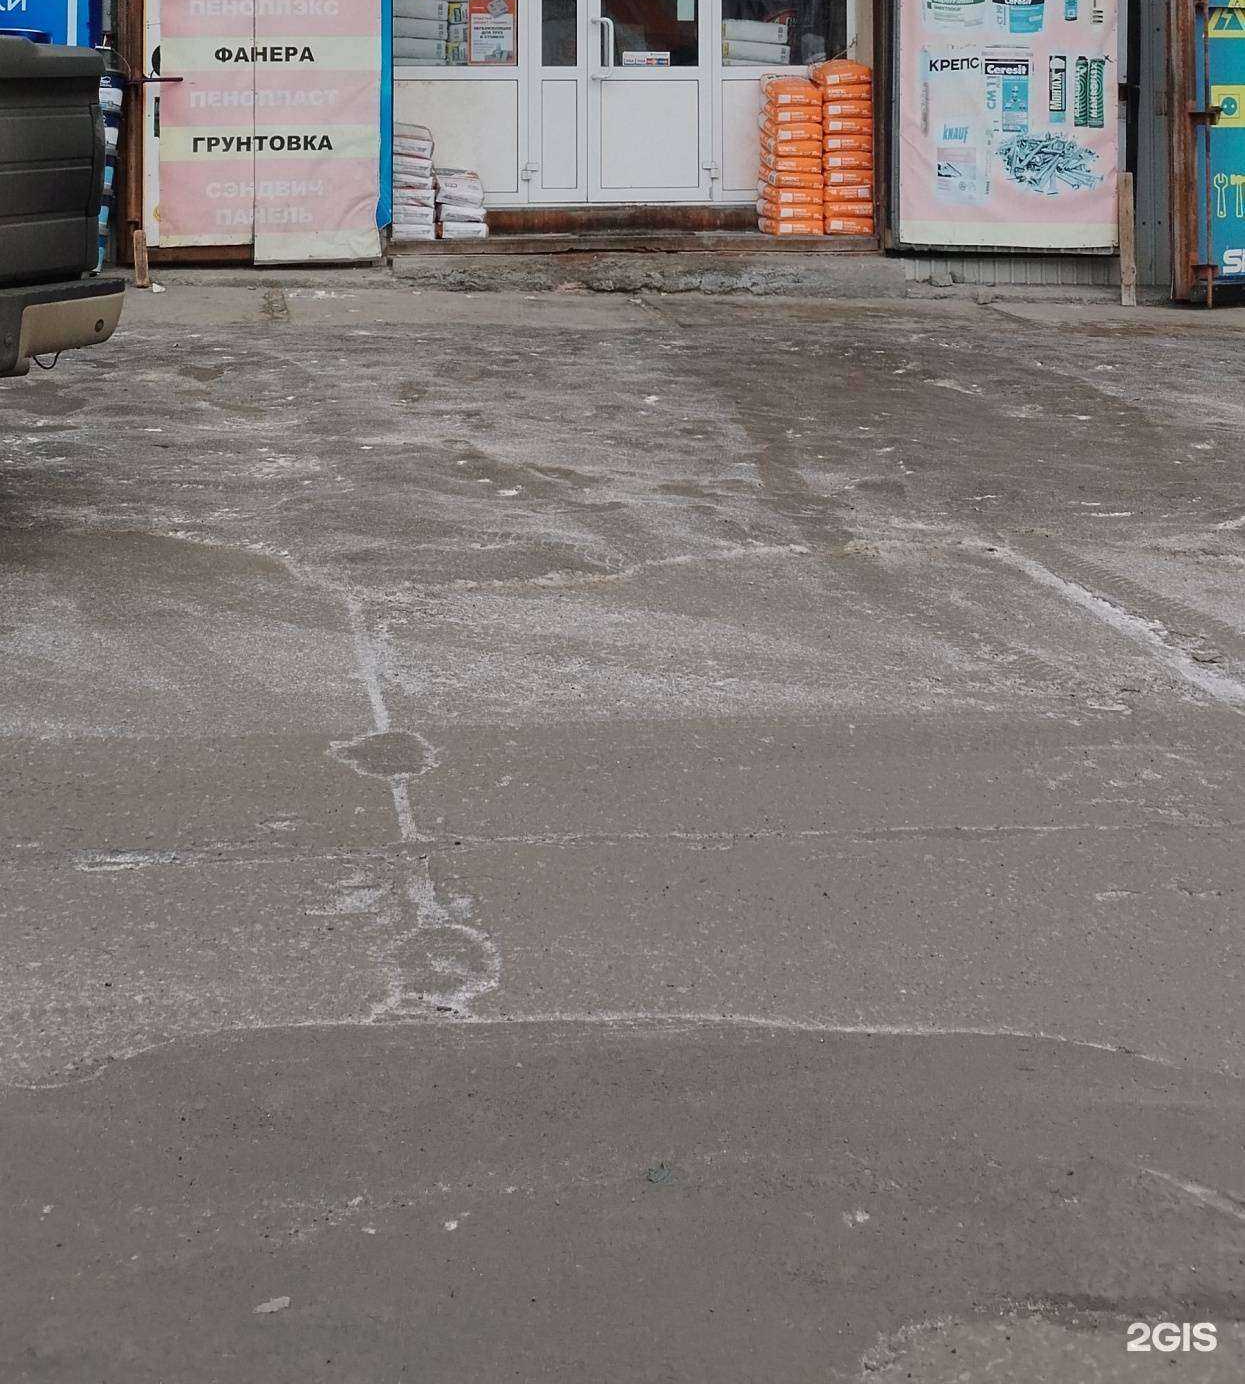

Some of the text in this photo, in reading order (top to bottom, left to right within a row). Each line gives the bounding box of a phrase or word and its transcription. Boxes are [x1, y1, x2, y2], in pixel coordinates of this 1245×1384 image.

[189, 0, 339, 16] ПЕНОПЛЭКС
[214, 46, 315, 63] ФАНЕРА
[929, 57, 979, 72] КРЕПС
[986, 64, 1027, 75] Ceresit
[189, 90, 338, 107] ПЕНОПЛАСТ
[192, 135, 333, 153] ГРУНТОВКА
[206, 180, 325, 200] СЭНДВИЧ
[1223, 249, 1245, 273] S
